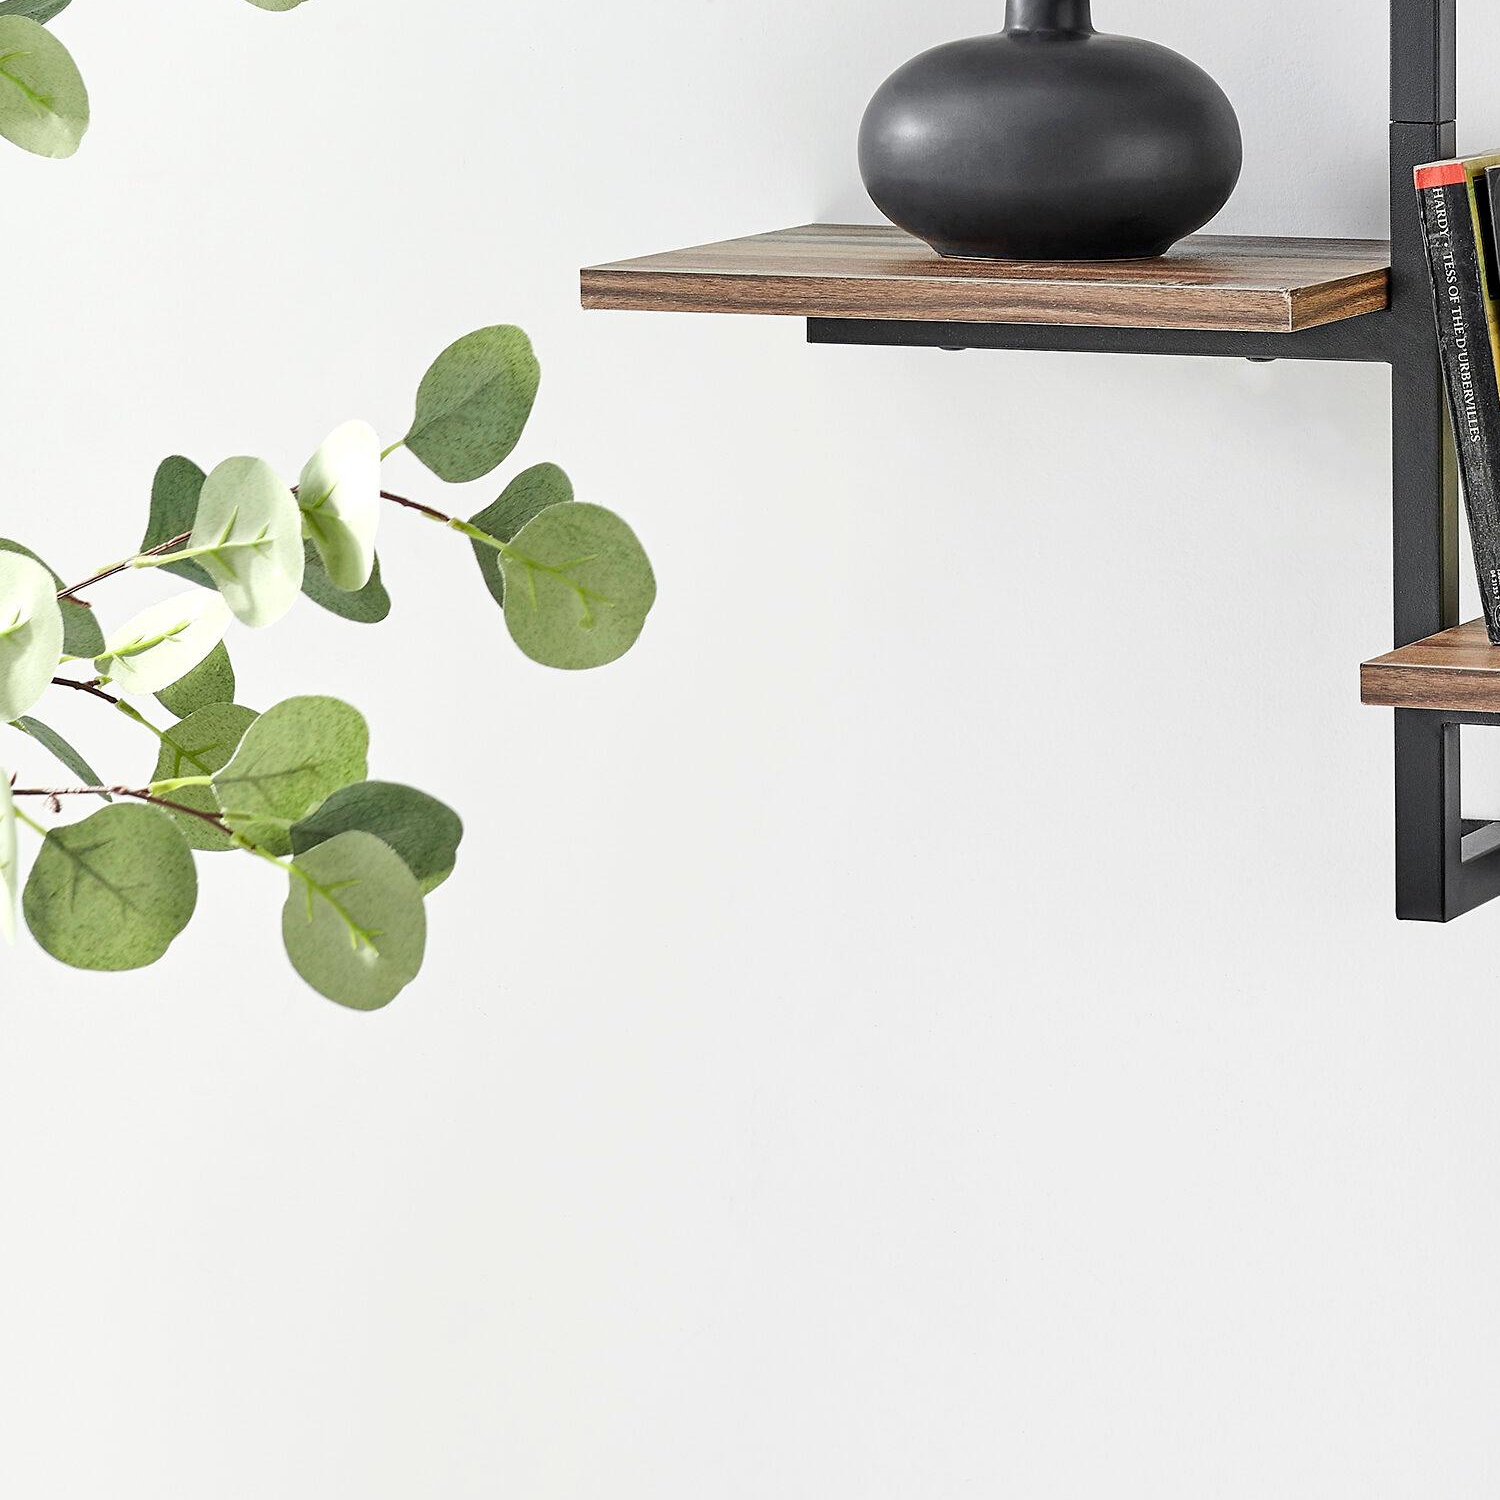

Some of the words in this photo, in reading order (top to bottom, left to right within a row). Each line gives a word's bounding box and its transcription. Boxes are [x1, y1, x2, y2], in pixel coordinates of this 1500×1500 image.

[1432, 187, 1450, 238] HARDY
[1443, 251, 1458, 284] TESS
[1448, 285, 1460, 304] OF
[1451, 305, 1465, 337] THE
[1455, 337, 1481, 442] D'URBERVILLES
